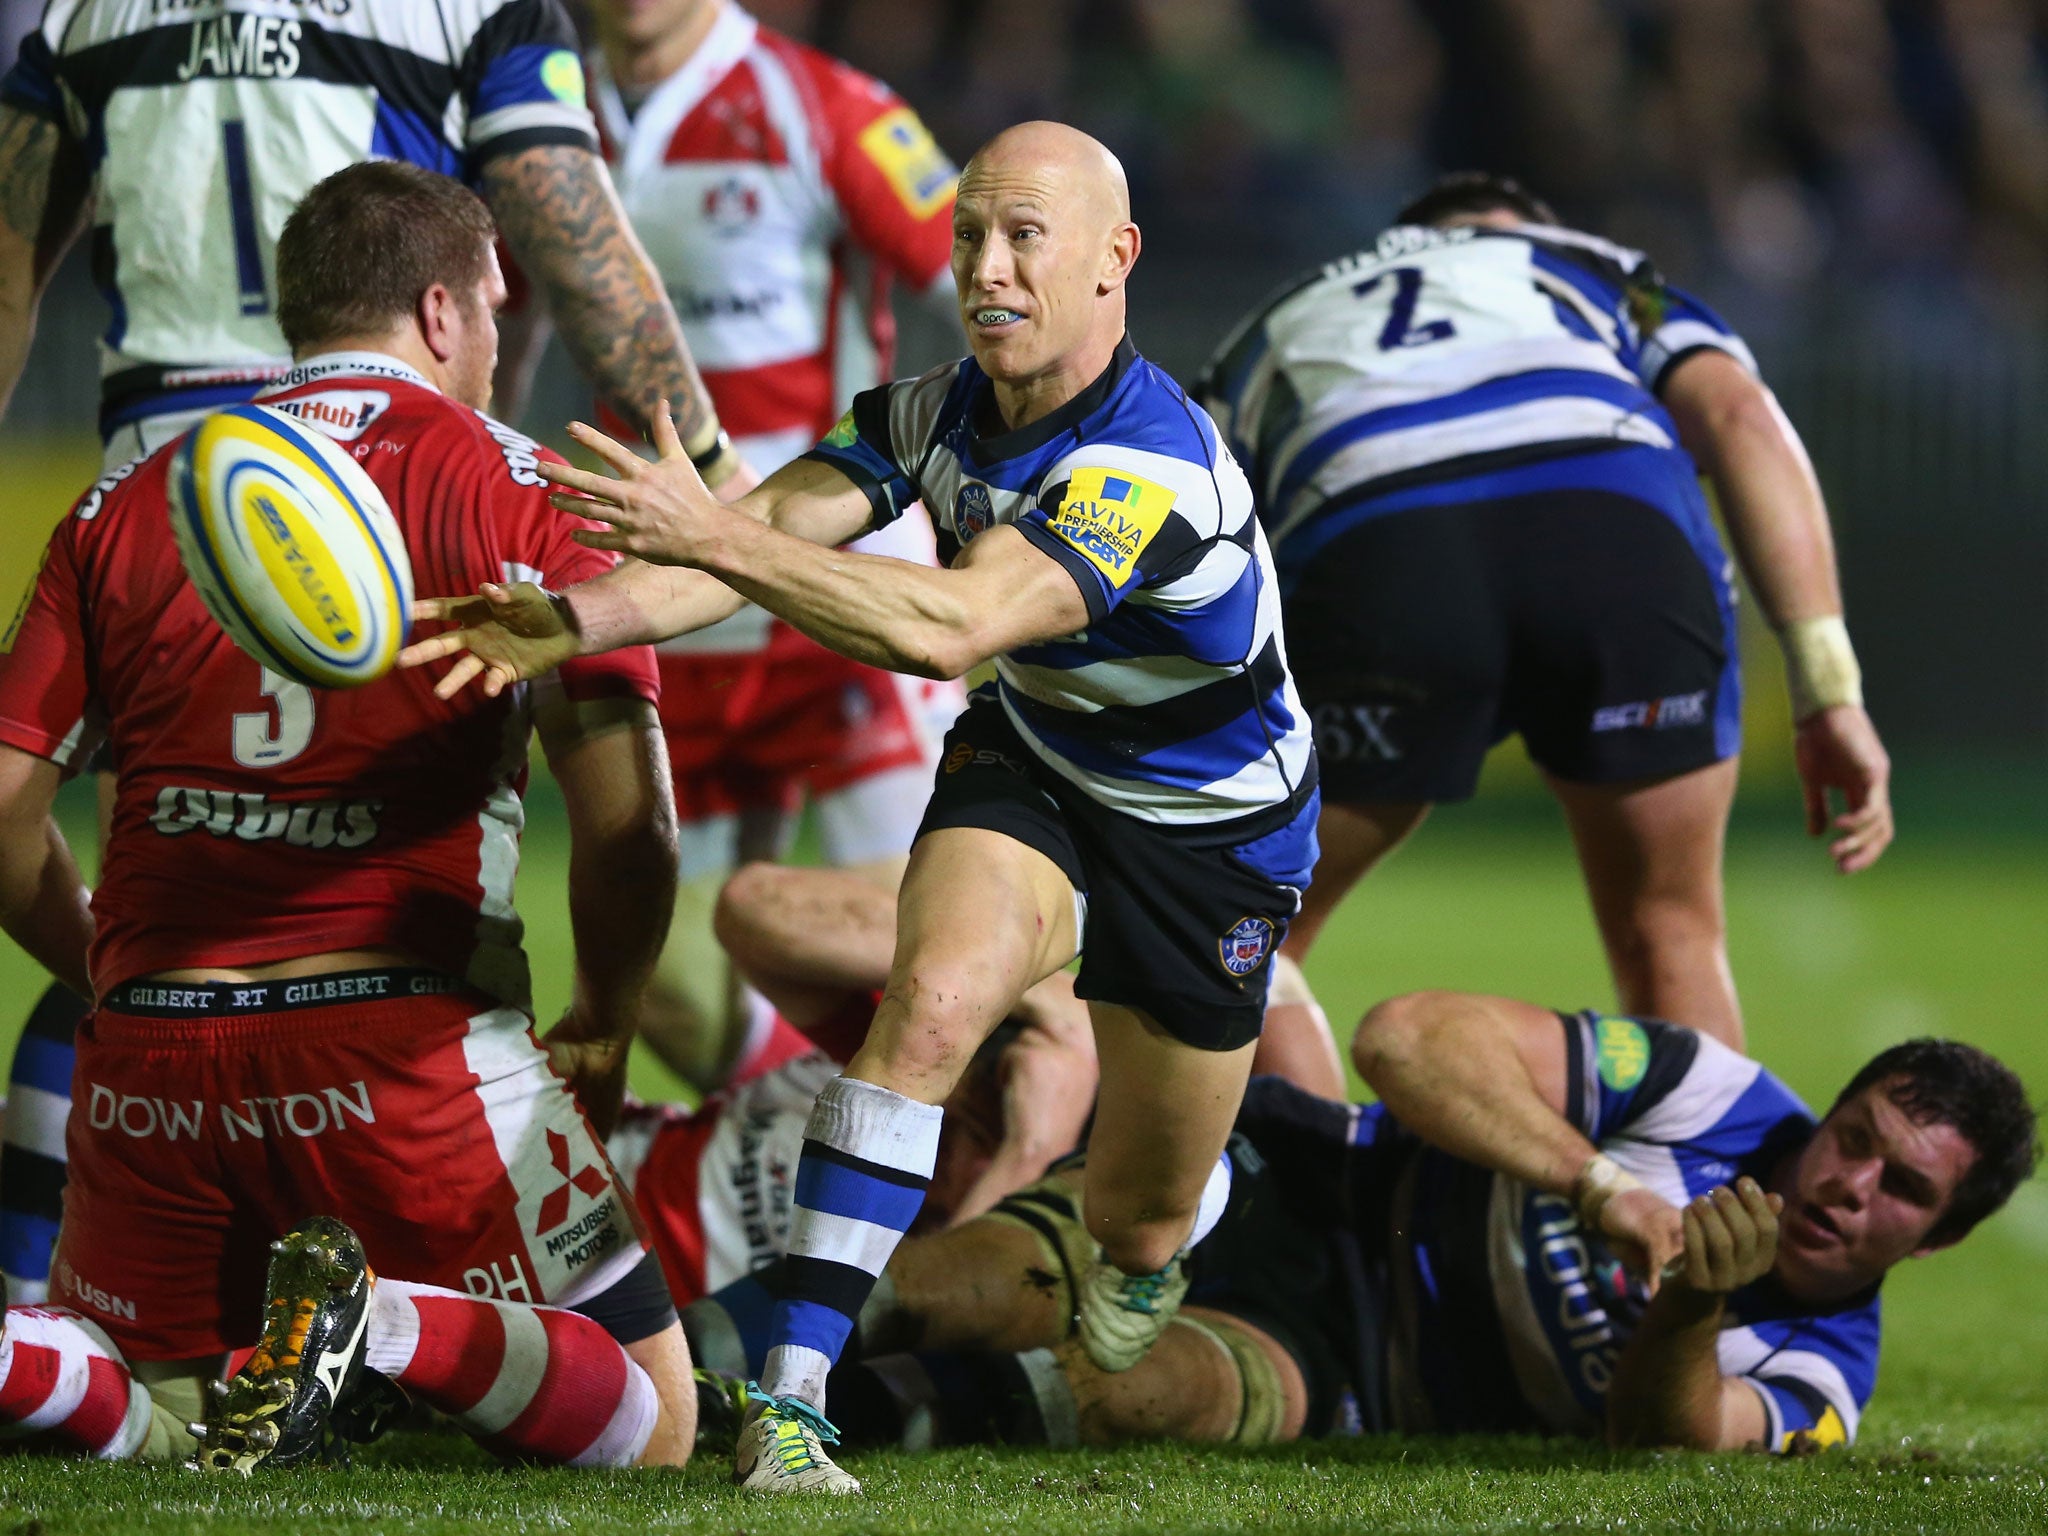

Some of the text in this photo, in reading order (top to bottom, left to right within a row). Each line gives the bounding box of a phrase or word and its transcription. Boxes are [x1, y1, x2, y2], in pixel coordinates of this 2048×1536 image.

[177, 13, 302, 82] JAMES
[1351, 266, 1458, 353] 2
[1063, 514, 1134, 556] PREMIERSHIP
[1067, 501, 1143, 548] AVIVA
[130, 987, 216, 1009] GILBERT
[285, 976, 390, 1005] GILBERT
[564, 1222, 620, 1271] MOTORS
[75, 1275, 137, 1320] USN
